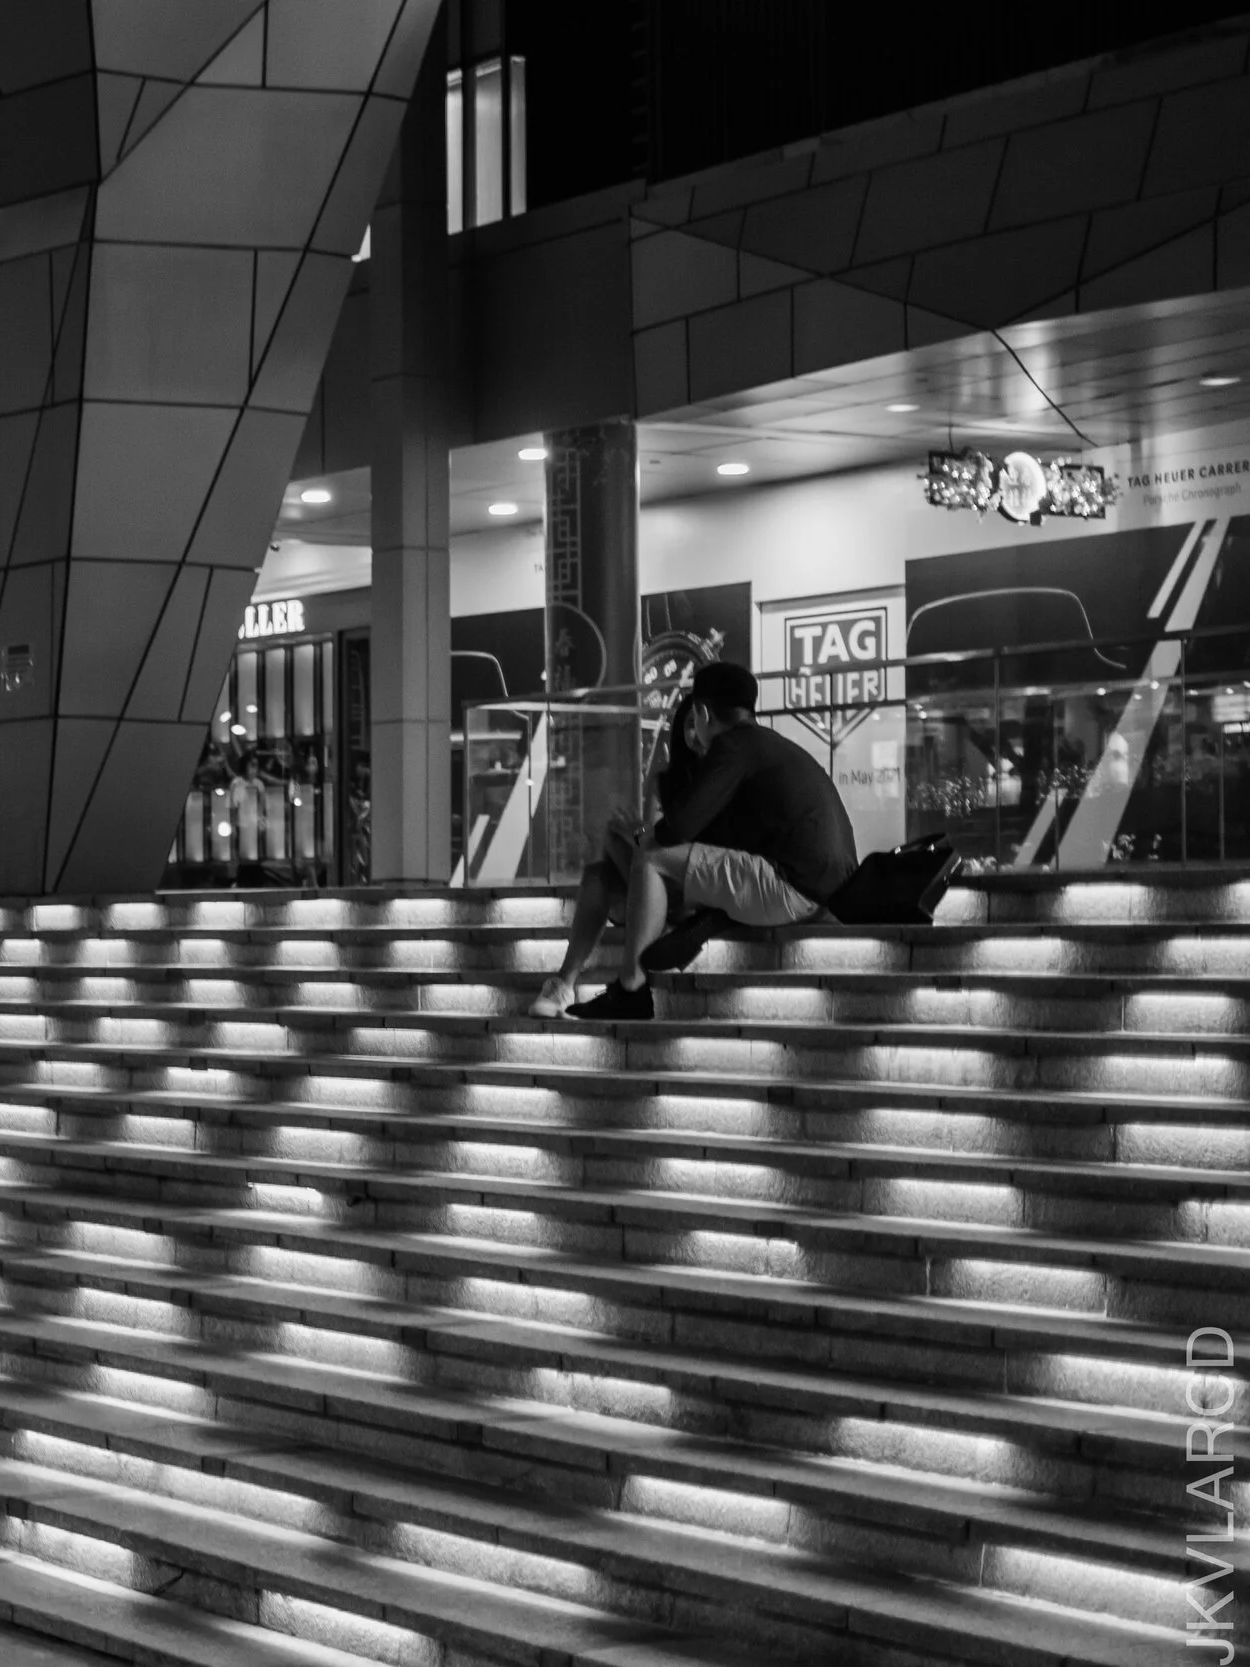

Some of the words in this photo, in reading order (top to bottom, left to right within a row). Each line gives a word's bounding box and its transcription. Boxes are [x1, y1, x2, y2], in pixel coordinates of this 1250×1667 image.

[1127, 473, 1151, 488] TAG
[1154, 467, 1195, 484] HEUER
[237, 599, 306, 640] LLER
[793, 619, 877, 666] TAG
[850, 768, 874, 788] May
